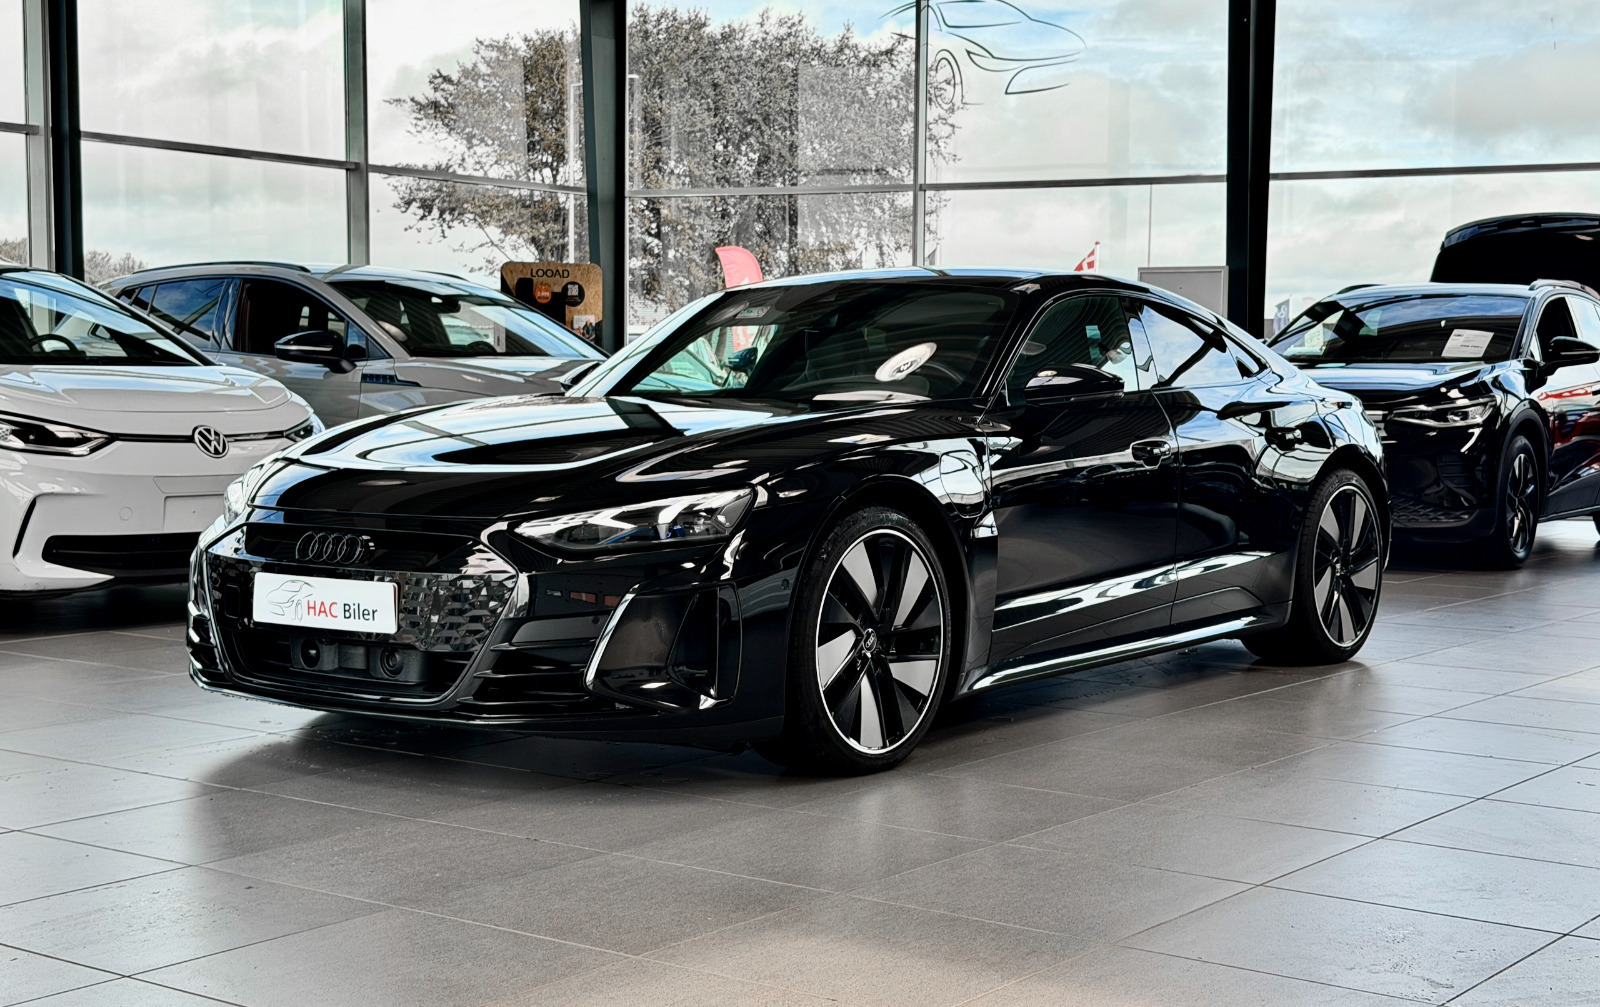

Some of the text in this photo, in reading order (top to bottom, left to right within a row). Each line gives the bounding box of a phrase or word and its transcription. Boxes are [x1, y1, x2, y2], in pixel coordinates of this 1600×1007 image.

[530, 268, 570, 279] LOOAD
[307, 600, 378, 621] HAC Biler
